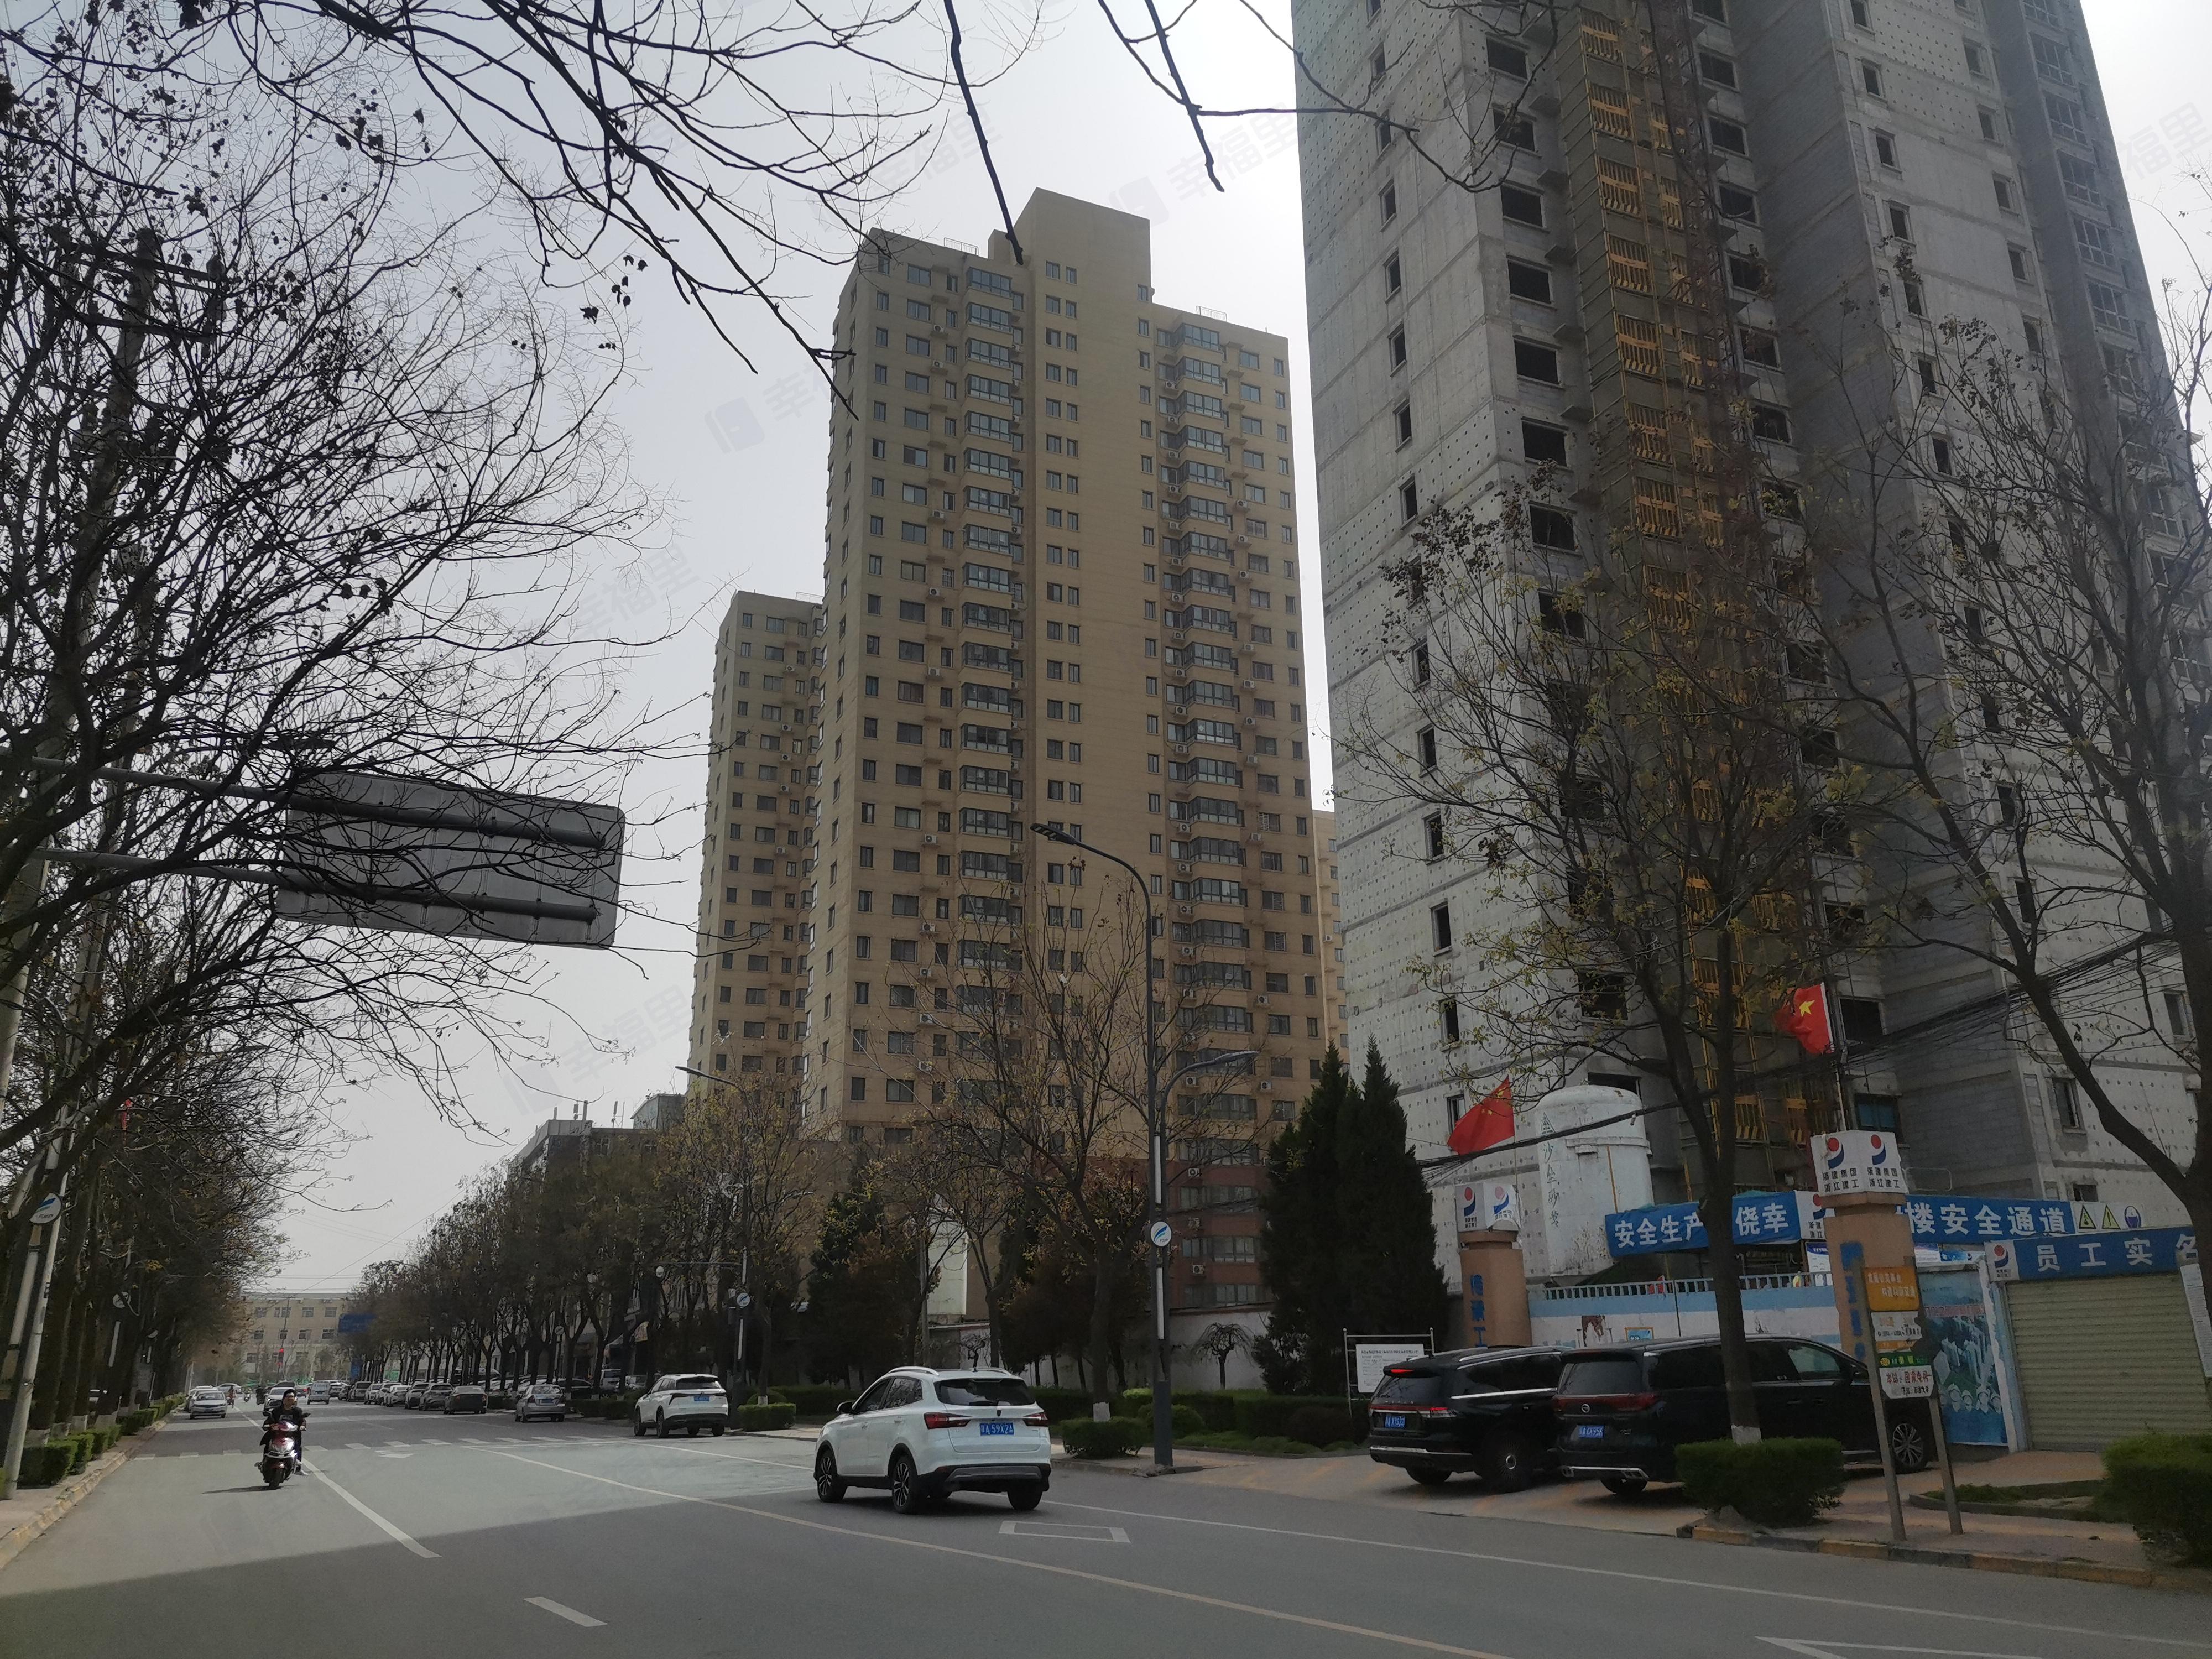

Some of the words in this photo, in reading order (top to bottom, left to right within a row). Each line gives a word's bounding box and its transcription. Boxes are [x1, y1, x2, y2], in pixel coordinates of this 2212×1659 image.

[1614, 1212, 1704, 1248] 安全生产
[1735, 1202, 1789, 1236] 侥幸
[1896, 1202, 2065, 1235] 楼安全通道
